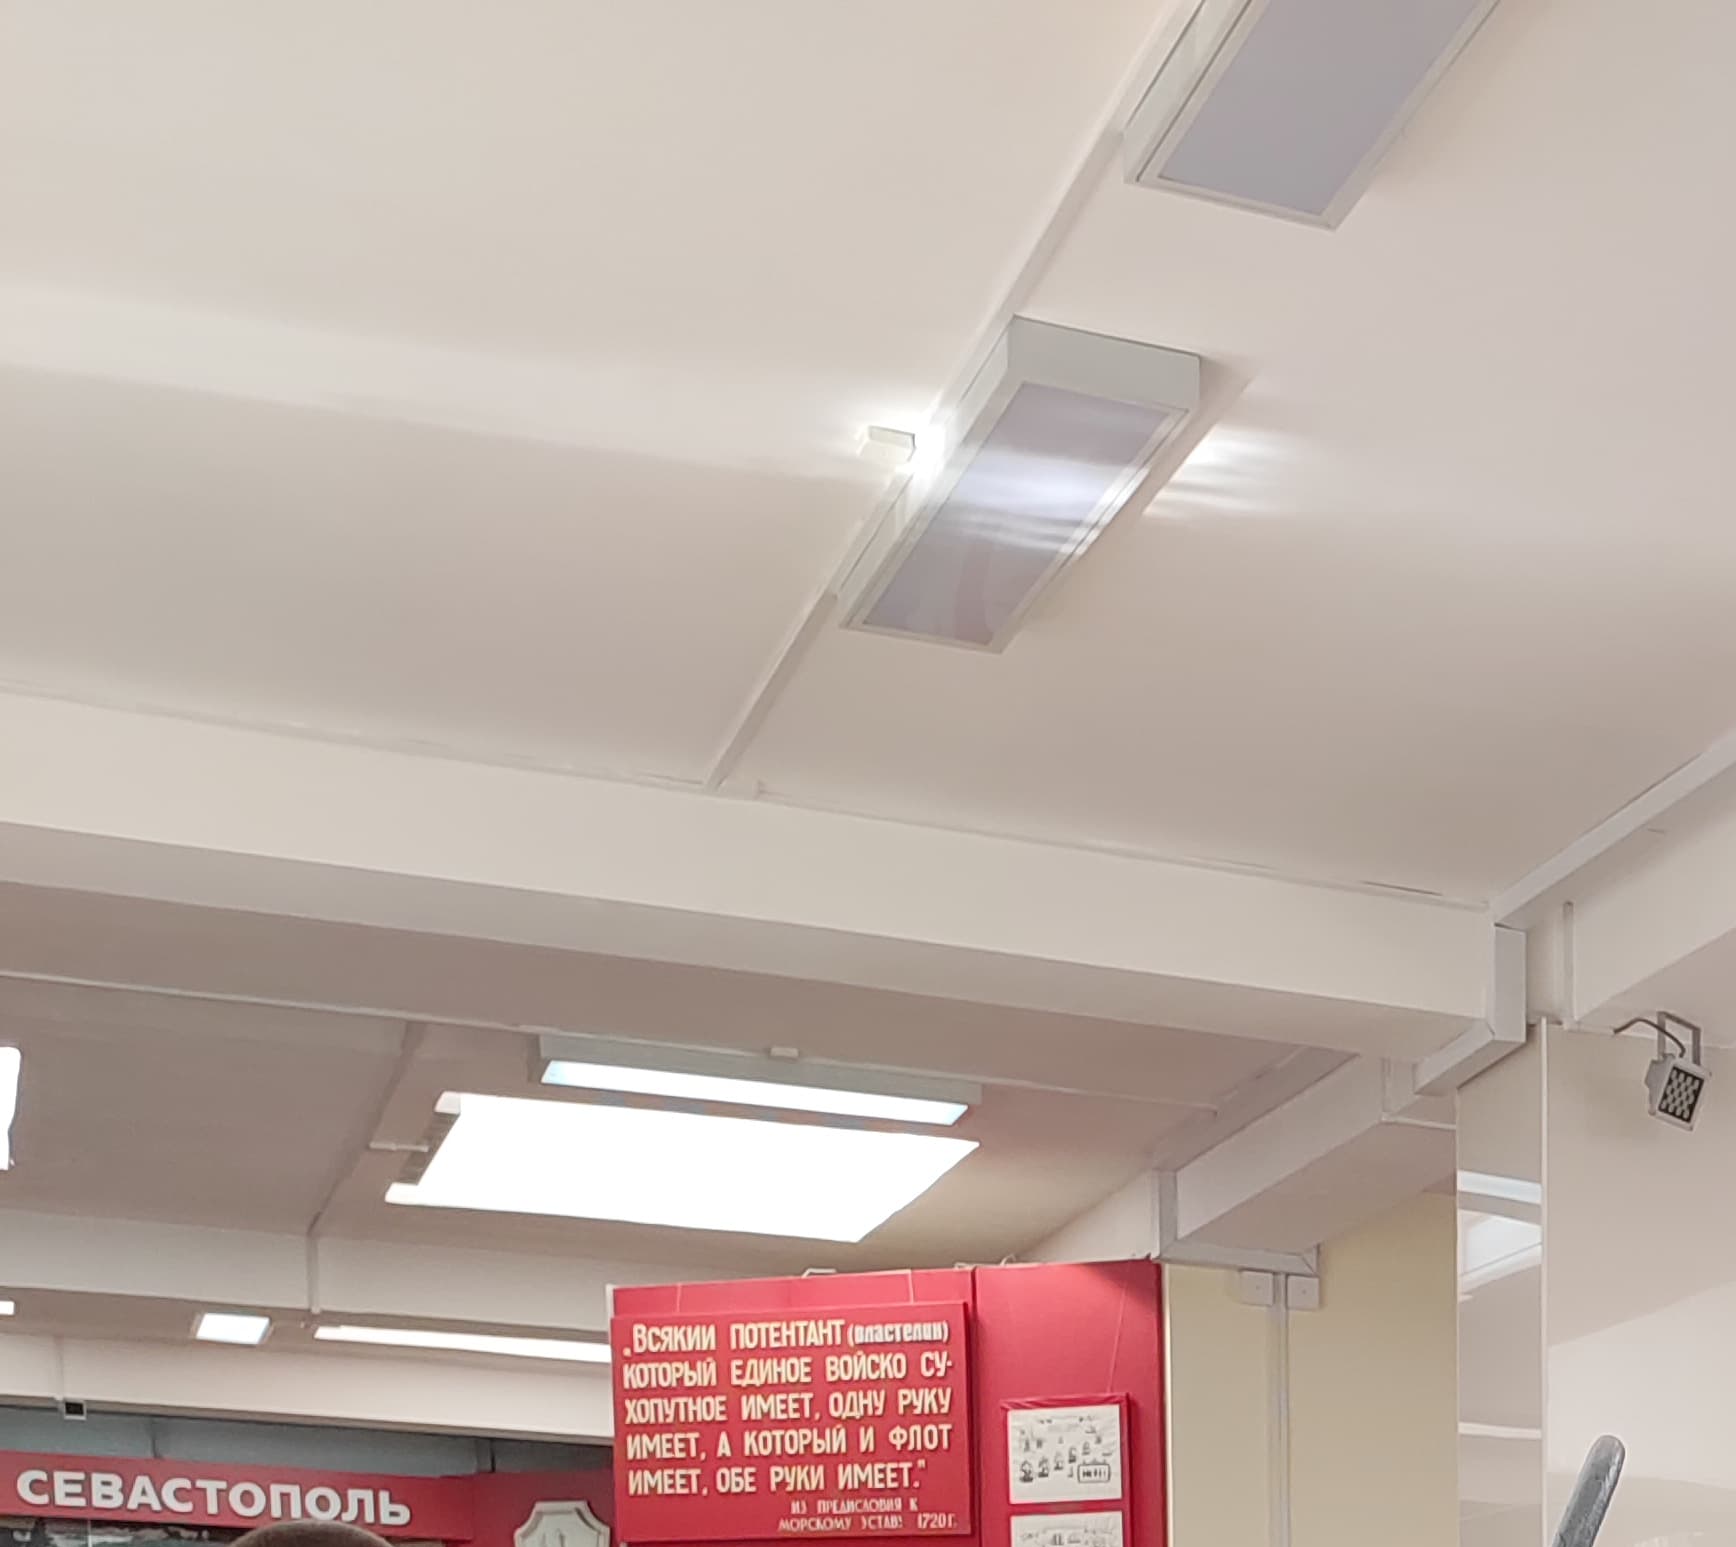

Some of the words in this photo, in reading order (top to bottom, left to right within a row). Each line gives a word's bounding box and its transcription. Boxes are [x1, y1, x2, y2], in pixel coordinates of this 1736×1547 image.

[729, 1319, 846, 1351] ПОТЕНТАНТ
[622, 1356, 718, 1390] КОТОРЫЙ
[730, 1357, 813, 1387] ЕДИНОЕ
[825, 1350, 908, 1383] ВОЙСКО
[920, 1350, 953, 1379] СУ-
[624, 1394, 728, 1425] ХОПУТНОЕ
[740, 1391, 820, 1421] ИМЕЕТ,
[828, 1388, 886, 1420] ОДНУ
[897, 1387, 952, 1416] РУКУ
[626, 1431, 707, 1461] ИМЕЕТ,
[716, 1430, 732, 1458] А
[743, 1424, 848, 1458] КОТОРЫЙ
[859, 1425, 875, 1453] И
[888, 1423, 953, 1451] ФЛОТ
[16, 1470, 411, 1526] СЕВАСТОПОЛЬ
[628, 1467, 709, 1497] ИМЕЕТ,
[715, 1466, 757, 1494] ОБЕ
[770, 1463, 825, 1492] РУКИ
[909, 1495, 919, 1512] К
[778, 1515, 853, 1533] МОРСКОМУ
